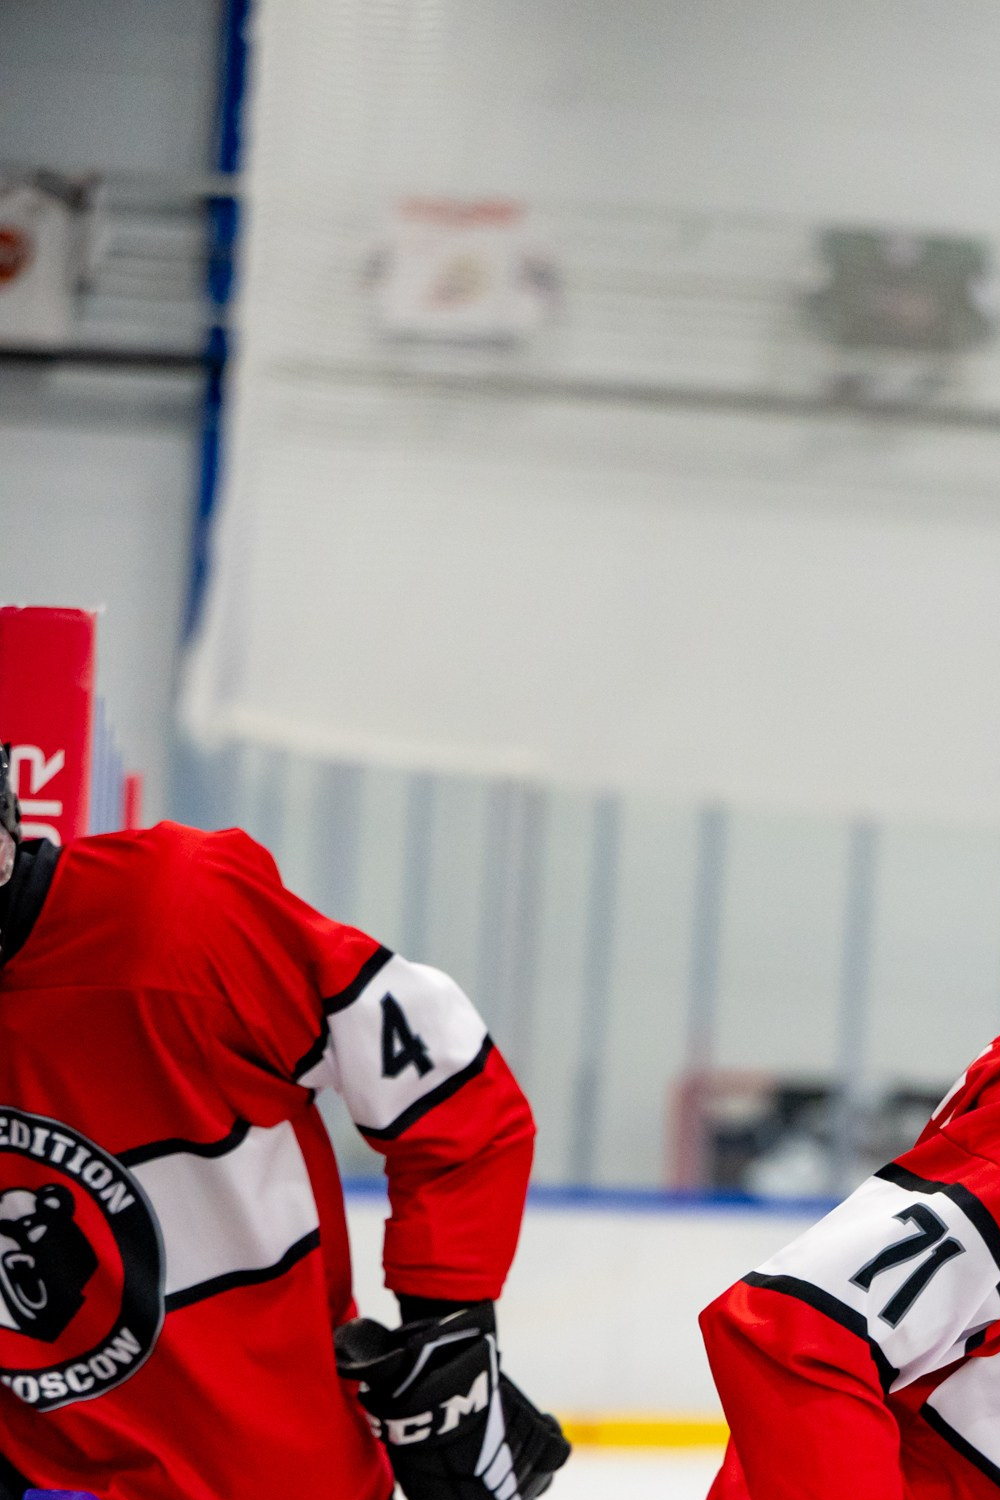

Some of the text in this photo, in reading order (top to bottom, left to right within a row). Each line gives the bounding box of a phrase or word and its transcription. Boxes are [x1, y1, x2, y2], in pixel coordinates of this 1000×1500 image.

[380, 991, 435, 1079] 4
[848, 1202, 967, 1330] 71
[1, 1327, 142, 1403] OSCOW
